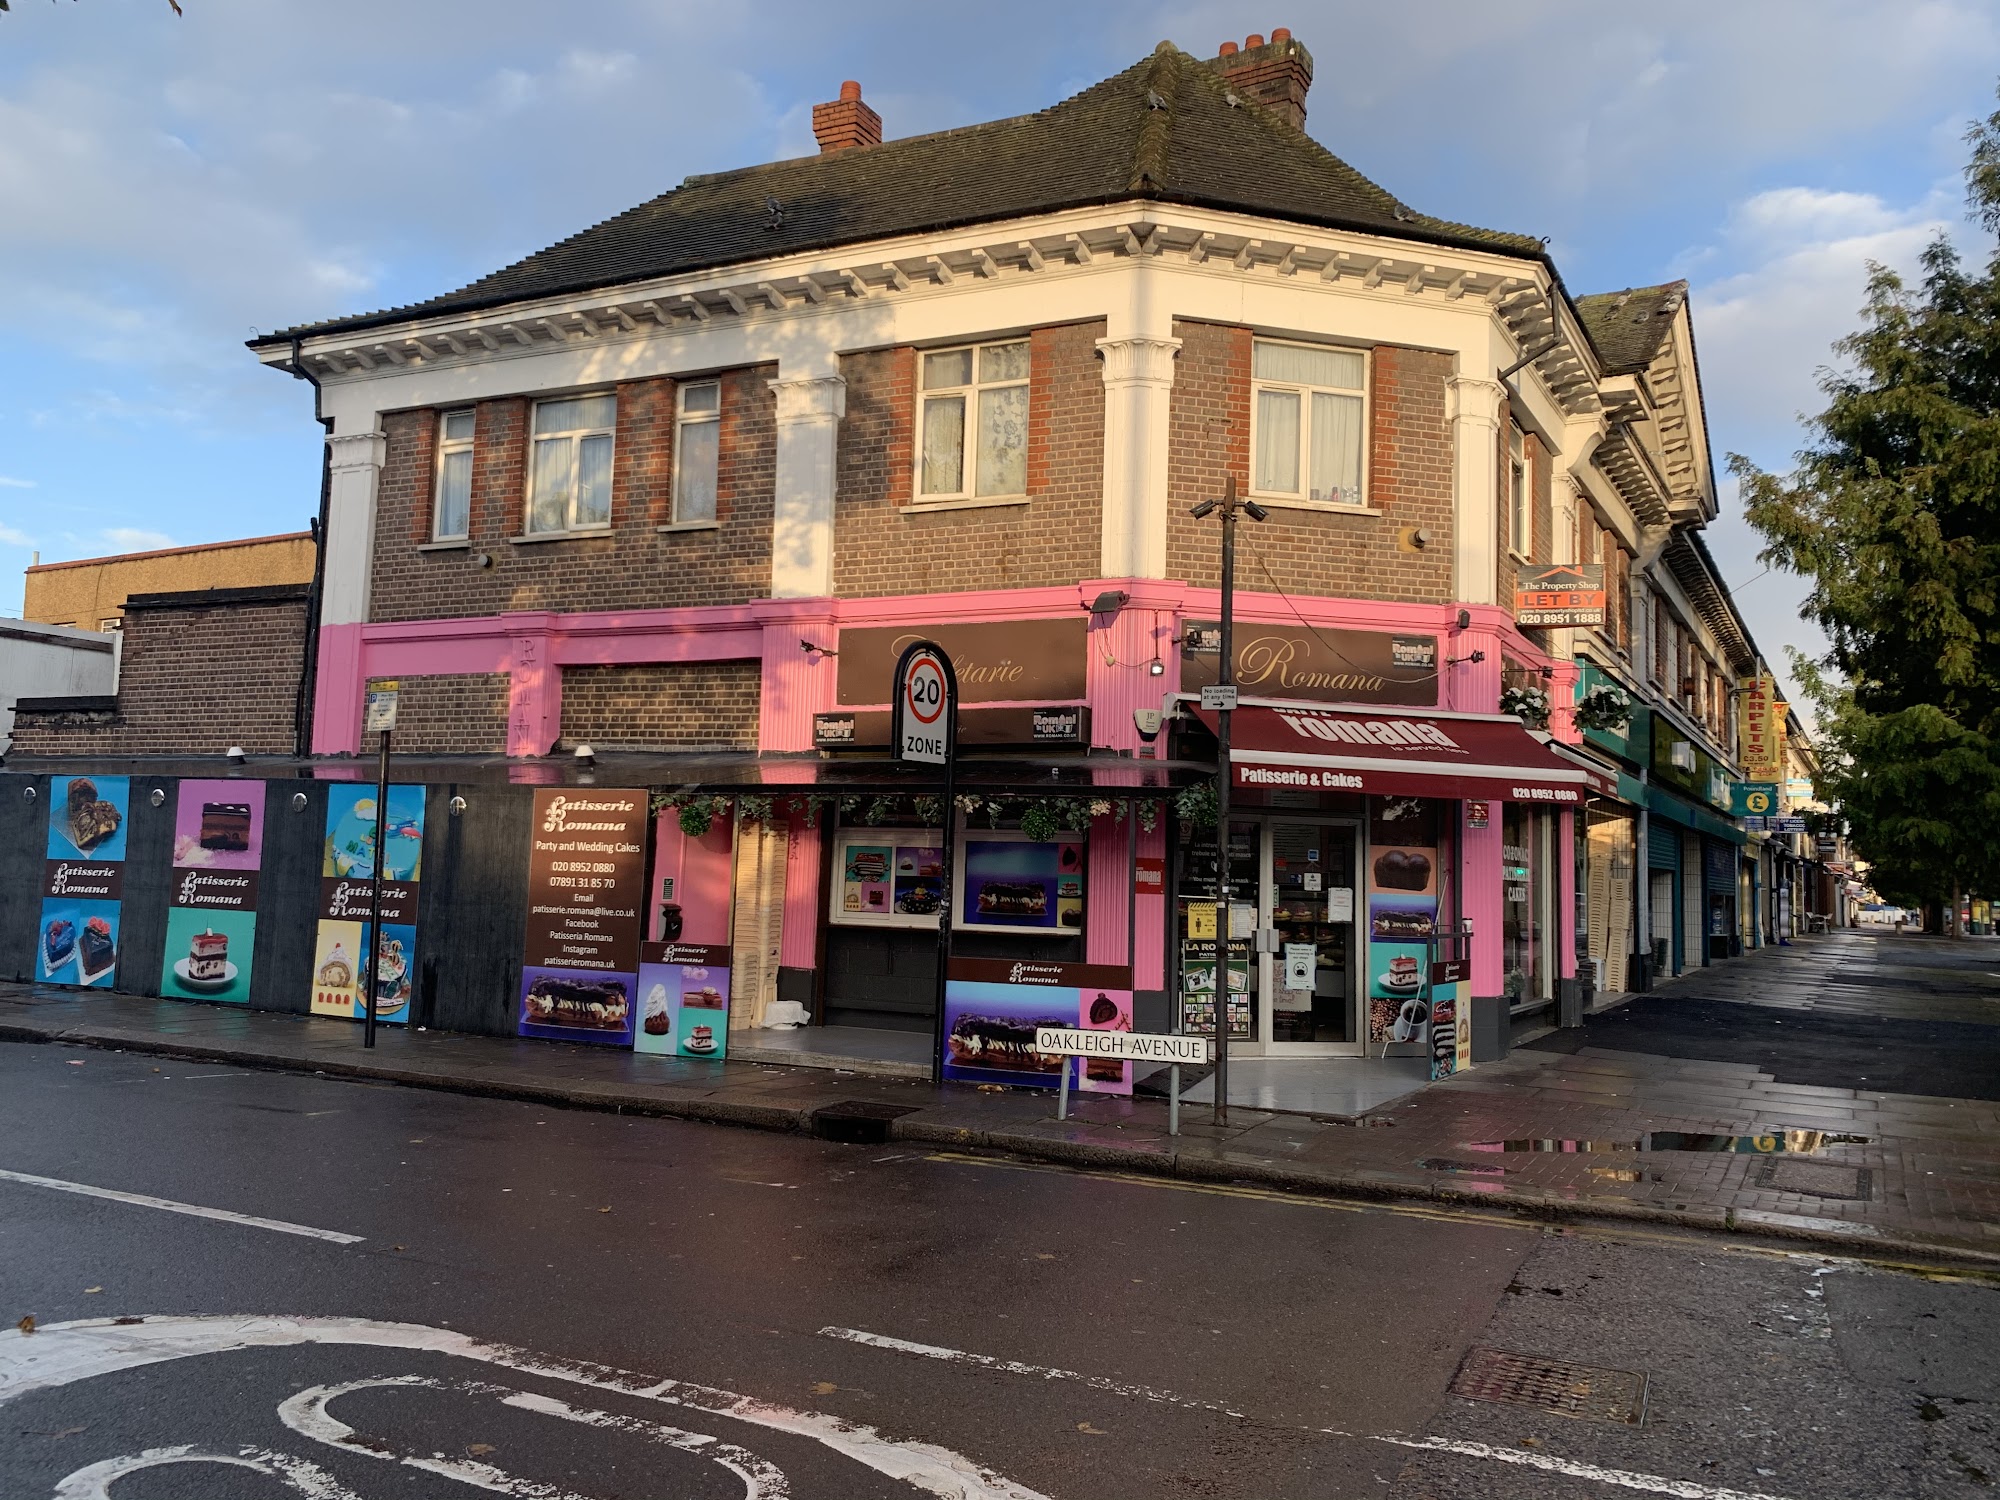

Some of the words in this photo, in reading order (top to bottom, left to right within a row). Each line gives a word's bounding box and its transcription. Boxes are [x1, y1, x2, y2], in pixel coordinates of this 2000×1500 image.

[1523, 582, 1540, 590] The
[1542, 582, 1577, 591] Property
[1578, 582, 1600, 590] Shop
[1524, 594, 1562, 606] LET
[1570, 594, 1596, 605] BY
[1520, 614, 1540, 624] 020
[1544, 614, 1570, 623] 8951
[1574, 614, 1602, 623] 1888
[1236, 636, 1385, 692] Romana
[913, 676, 940, 705] 20
[1748, 681, 1766, 753] CARPETS
[1280, 714, 1460, 748] romana
[907, 736, 942, 756] ZONE
[1240, 767, 1308, 786] Patisserie
[1310, 772, 1320, 786] &
[1322, 772, 1363, 789] Cakes
[1512, 787, 1529, 799] 020
[1531, 787, 1554, 801] 8952
[1556, 789, 1578, 801] 0880
[552, 796, 635, 813] Patisserie
[544, 809, 626, 832] Romana
[536, 840, 557, 853] Party
[559, 841, 575, 851] and
[576, 842, 614, 854] Wedding
[616, 843, 640, 853] Cakes
[58, 862, 115, 878] Patisserie
[552, 862, 568, 872] 020
[570, 863, 592, 872] 8952
[593, 863, 615, 873] 0880
[186, 871, 249, 888] Patisserie
[550, 877, 576, 887] 07891
[578, 878, 587, 888] 31
[589, 878, 602, 888] 85
[604, 879, 615, 889] 70
[1136, 870, 1161, 882] romana
[52, 876, 108, 896] Romana
[180, 886, 242, 907] Romana
[574, 893, 594, 903] Email
[1508, 887, 1526, 902] CAKES
[329, 896, 400, 917] Romna
[532, 905, 635, 918] patisserie.romana@live.co.uk
[565, 919, 599, 929] Facebook
[550, 930, 582, 941] Patisseria
[584, 932, 613, 942] Romana
[563, 944, 598, 955] Instagram
[667, 944, 708, 955] Patisserie
[544, 957, 615, 969] patisserieromana.uk
[662, 952, 704, 963] Romana
[1014, 962, 1063, 974] Patisserie
[1009, 971, 1058, 984] Romana
[1040, 1032, 1124, 1053] OAKLEIGH
[1132, 1038, 1202, 1058] AVENUE
